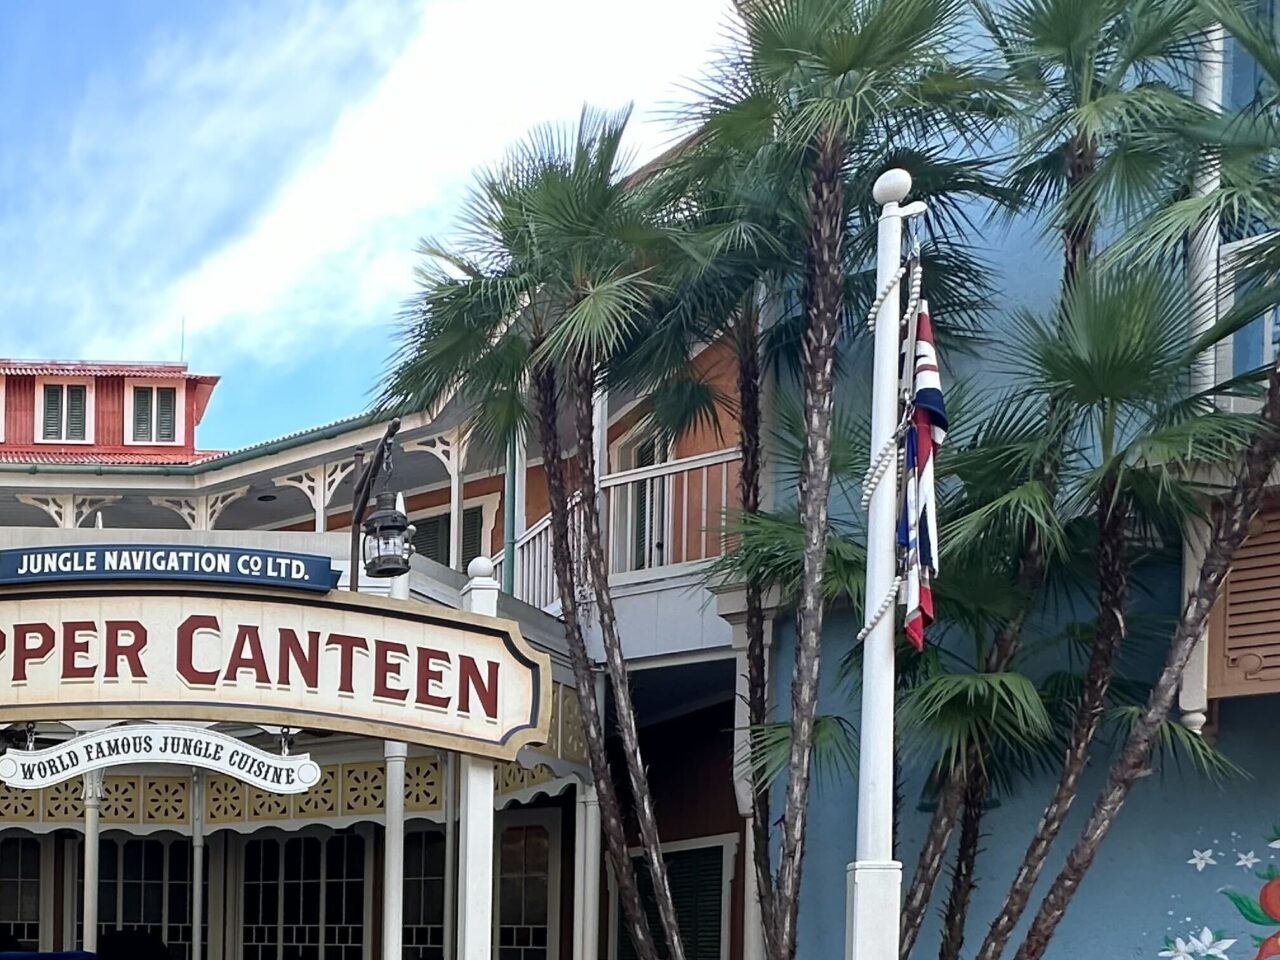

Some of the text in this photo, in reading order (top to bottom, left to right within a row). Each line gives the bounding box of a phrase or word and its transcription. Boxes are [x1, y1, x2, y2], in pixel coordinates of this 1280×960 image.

[17, 551, 97, 575] JUNGLE
[104, 550, 231, 573] NAVIGATION
[266, 556, 310, 580] LTD.
[176, 614, 501, 719] CANTEEN
[20, 735, 296, 785] WORLD FAMOUS JUNGLE CUISINE
